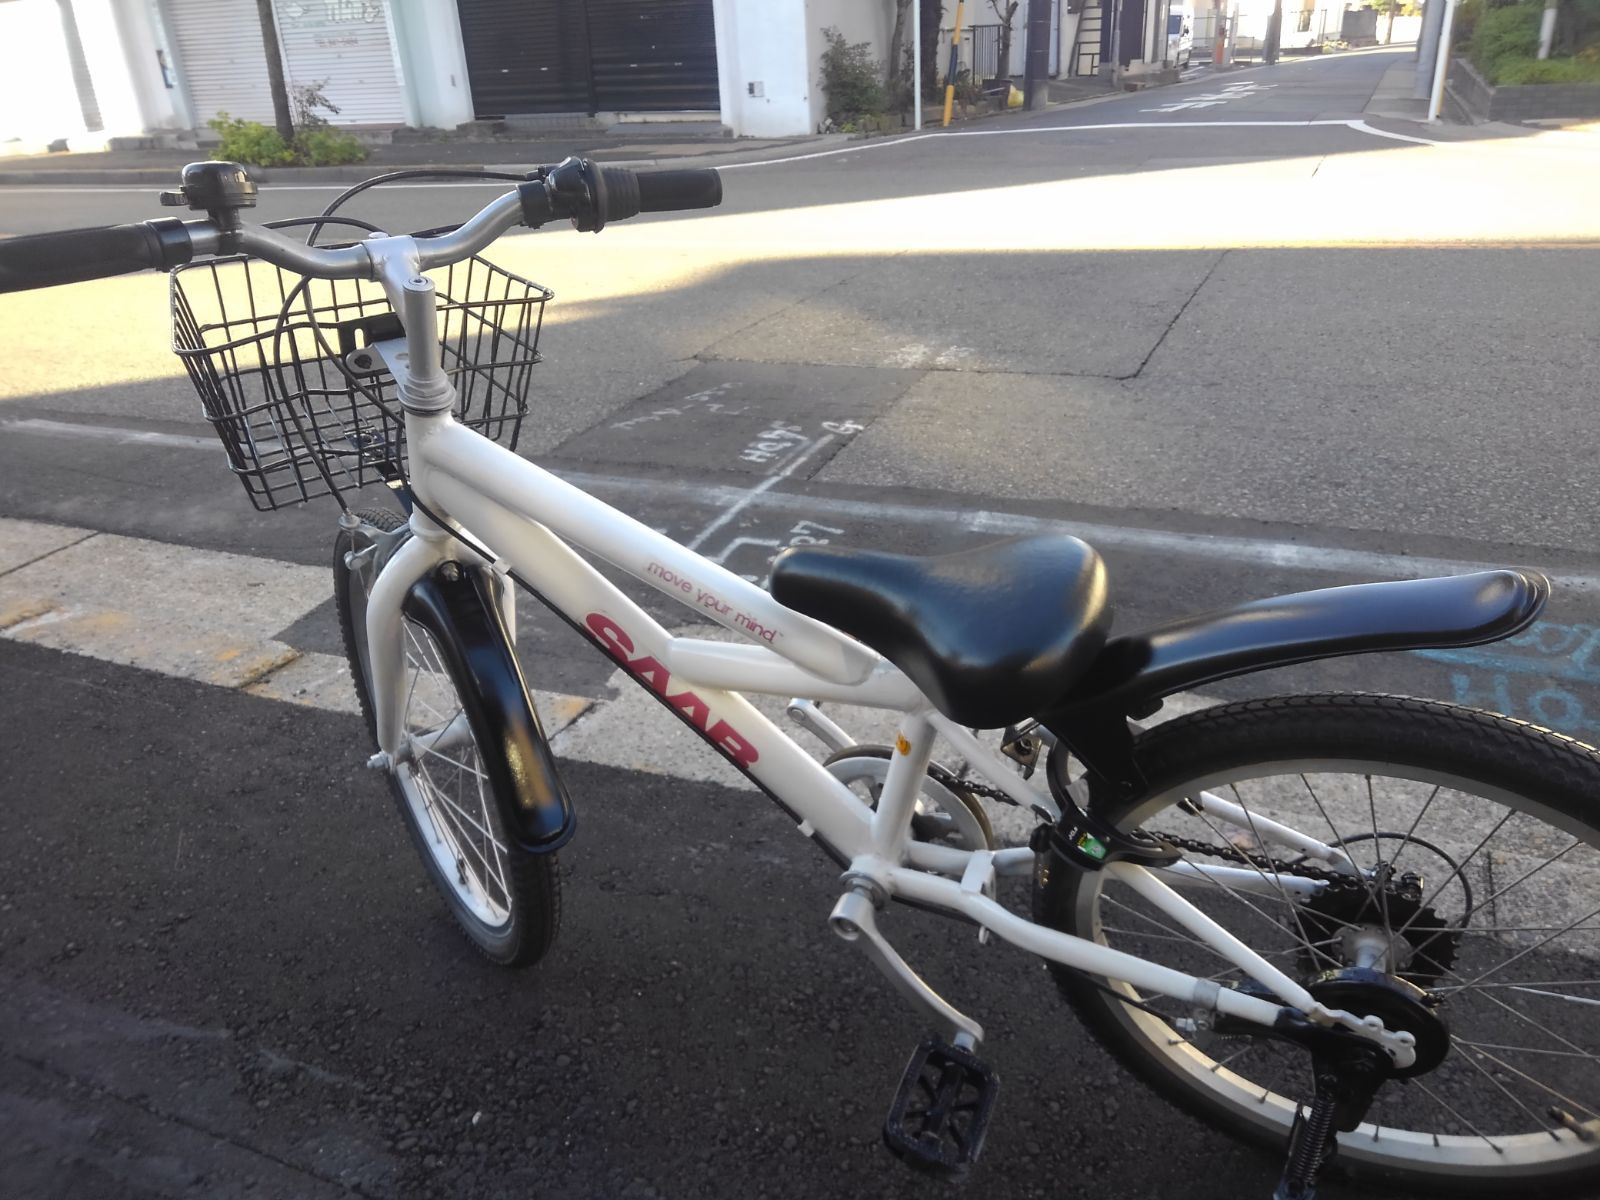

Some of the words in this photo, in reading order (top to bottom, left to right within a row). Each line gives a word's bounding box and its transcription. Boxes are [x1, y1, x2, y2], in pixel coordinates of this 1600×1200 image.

[647, 562, 693, 592] move
[696, 588, 733, 614] your
[735, 612, 776, 644] mind
[586, 613, 759, 768] SAAB
